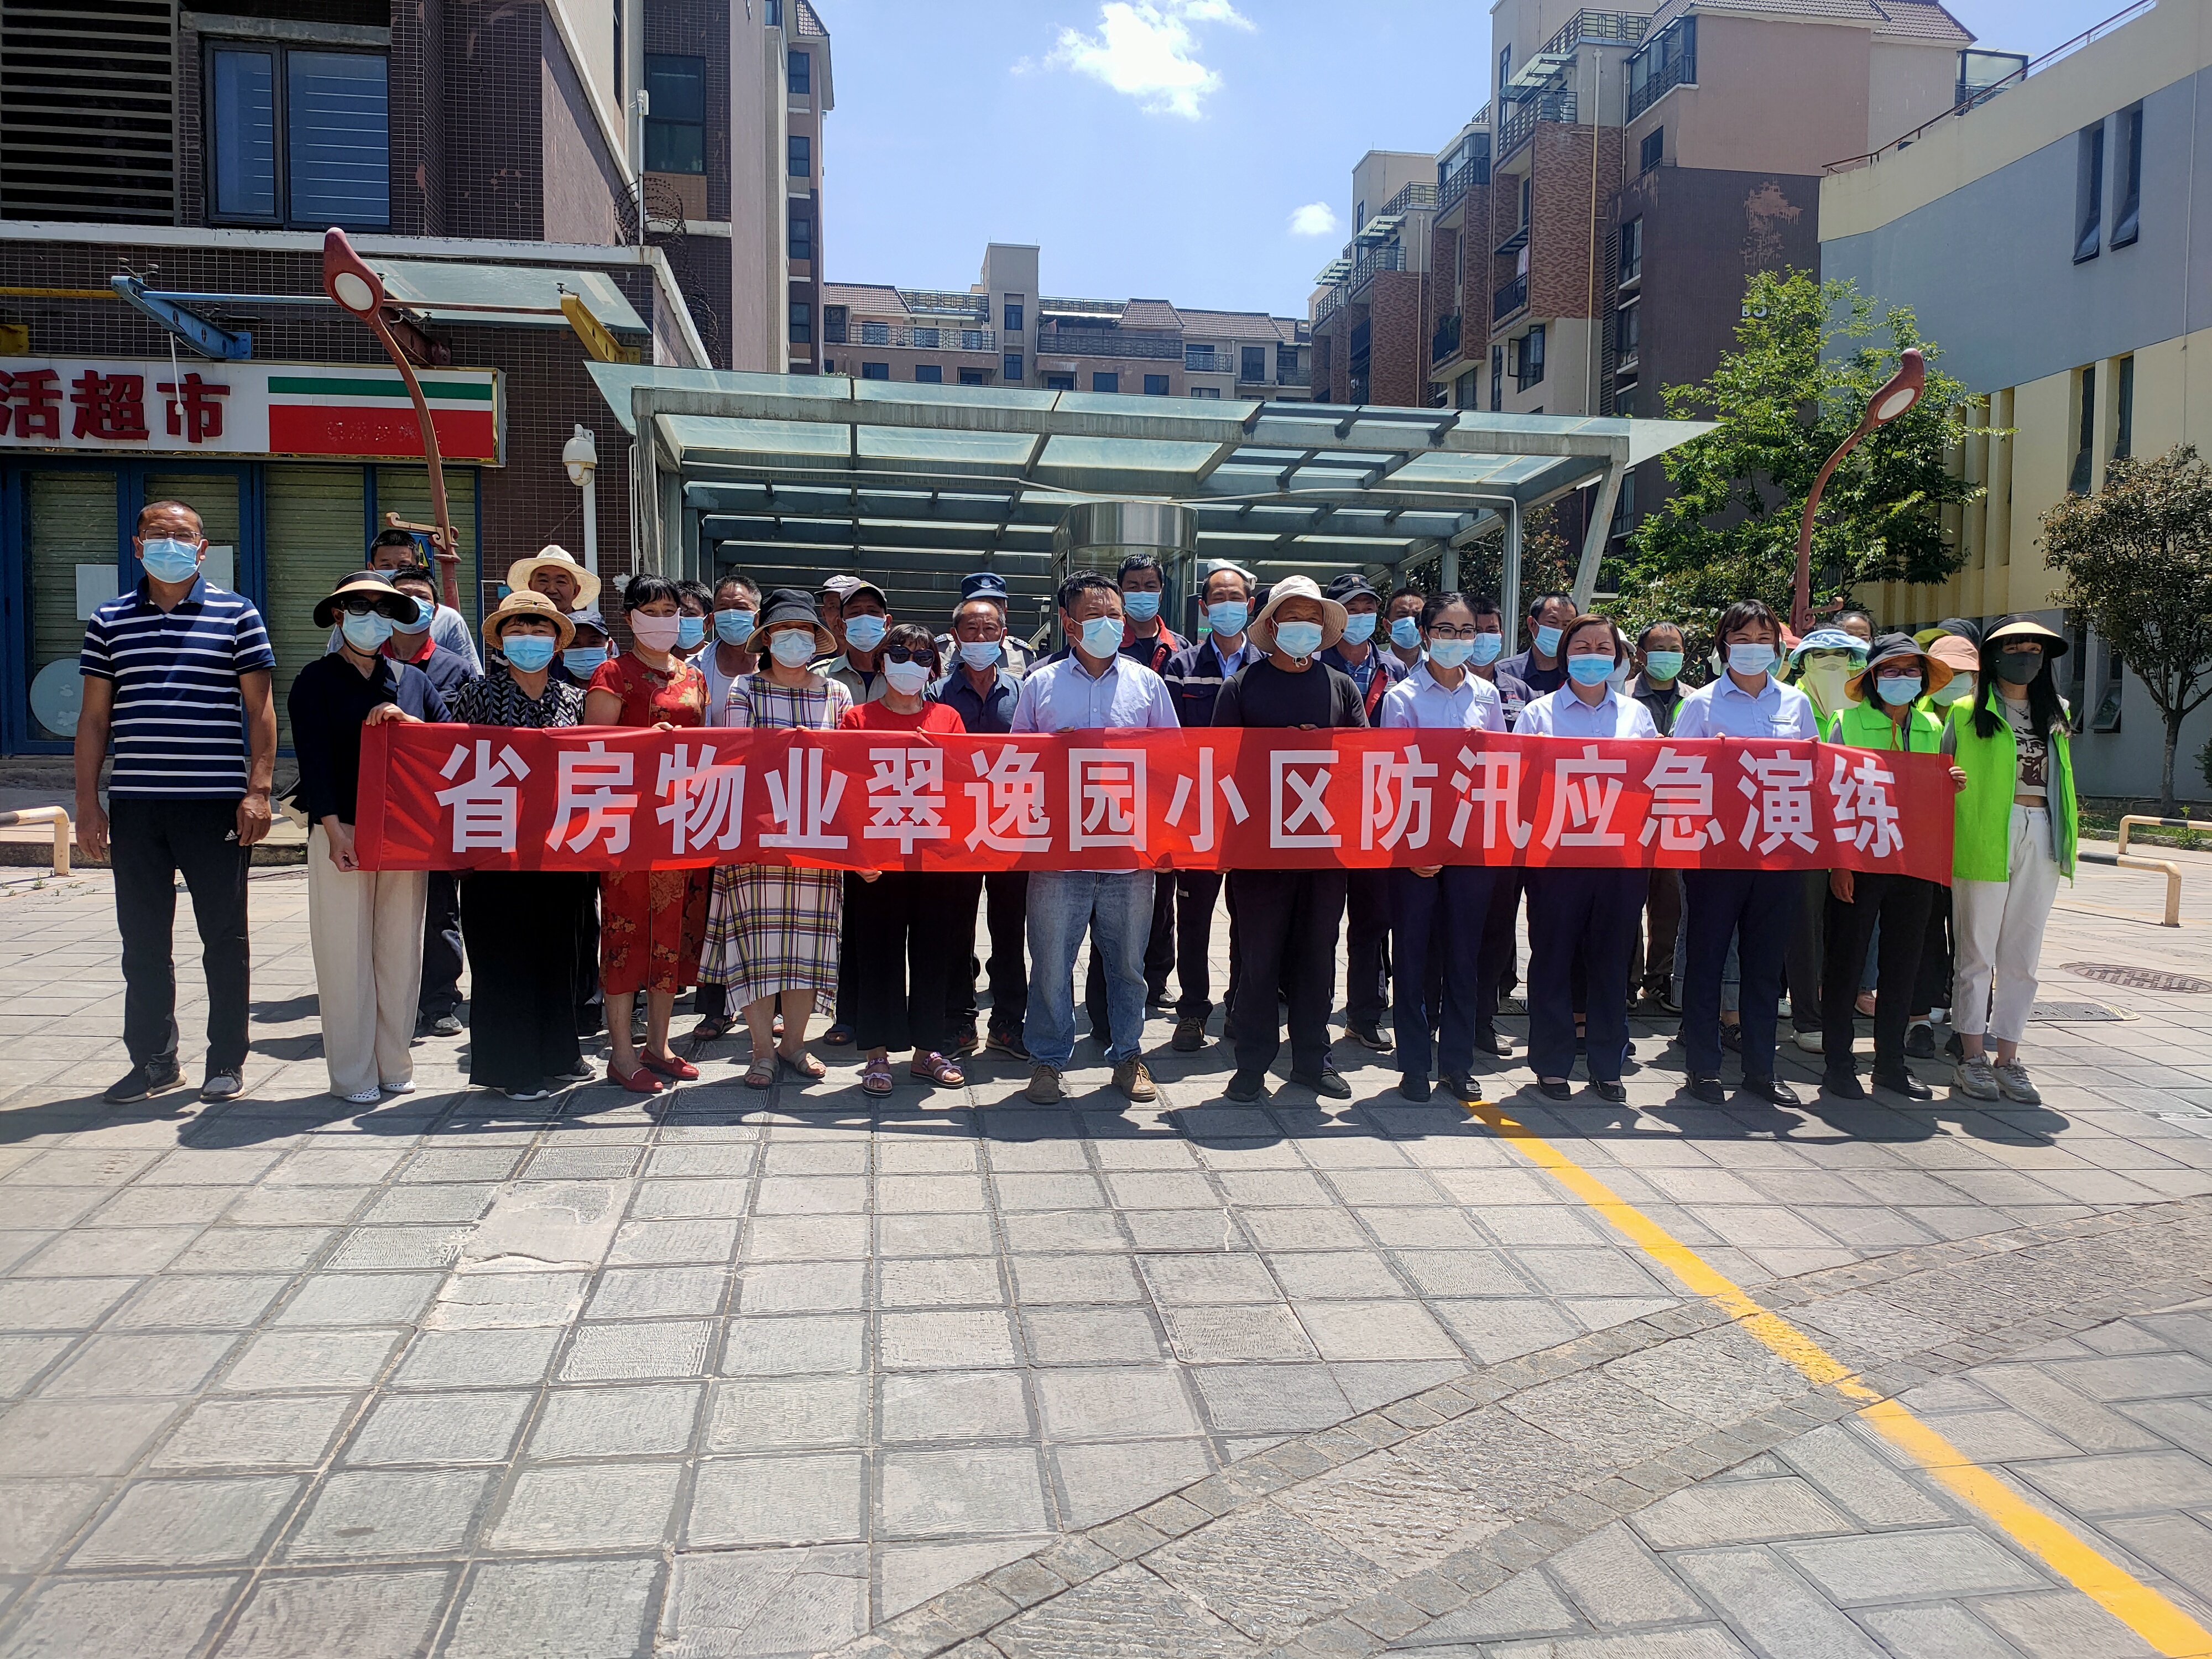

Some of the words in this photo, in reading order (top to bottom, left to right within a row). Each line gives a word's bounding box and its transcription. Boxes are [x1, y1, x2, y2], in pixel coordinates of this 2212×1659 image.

[0, 369, 231, 443] 活超市
[435, 739, 1904, 858] 省房物业翠逸园小区防汛应急演练
